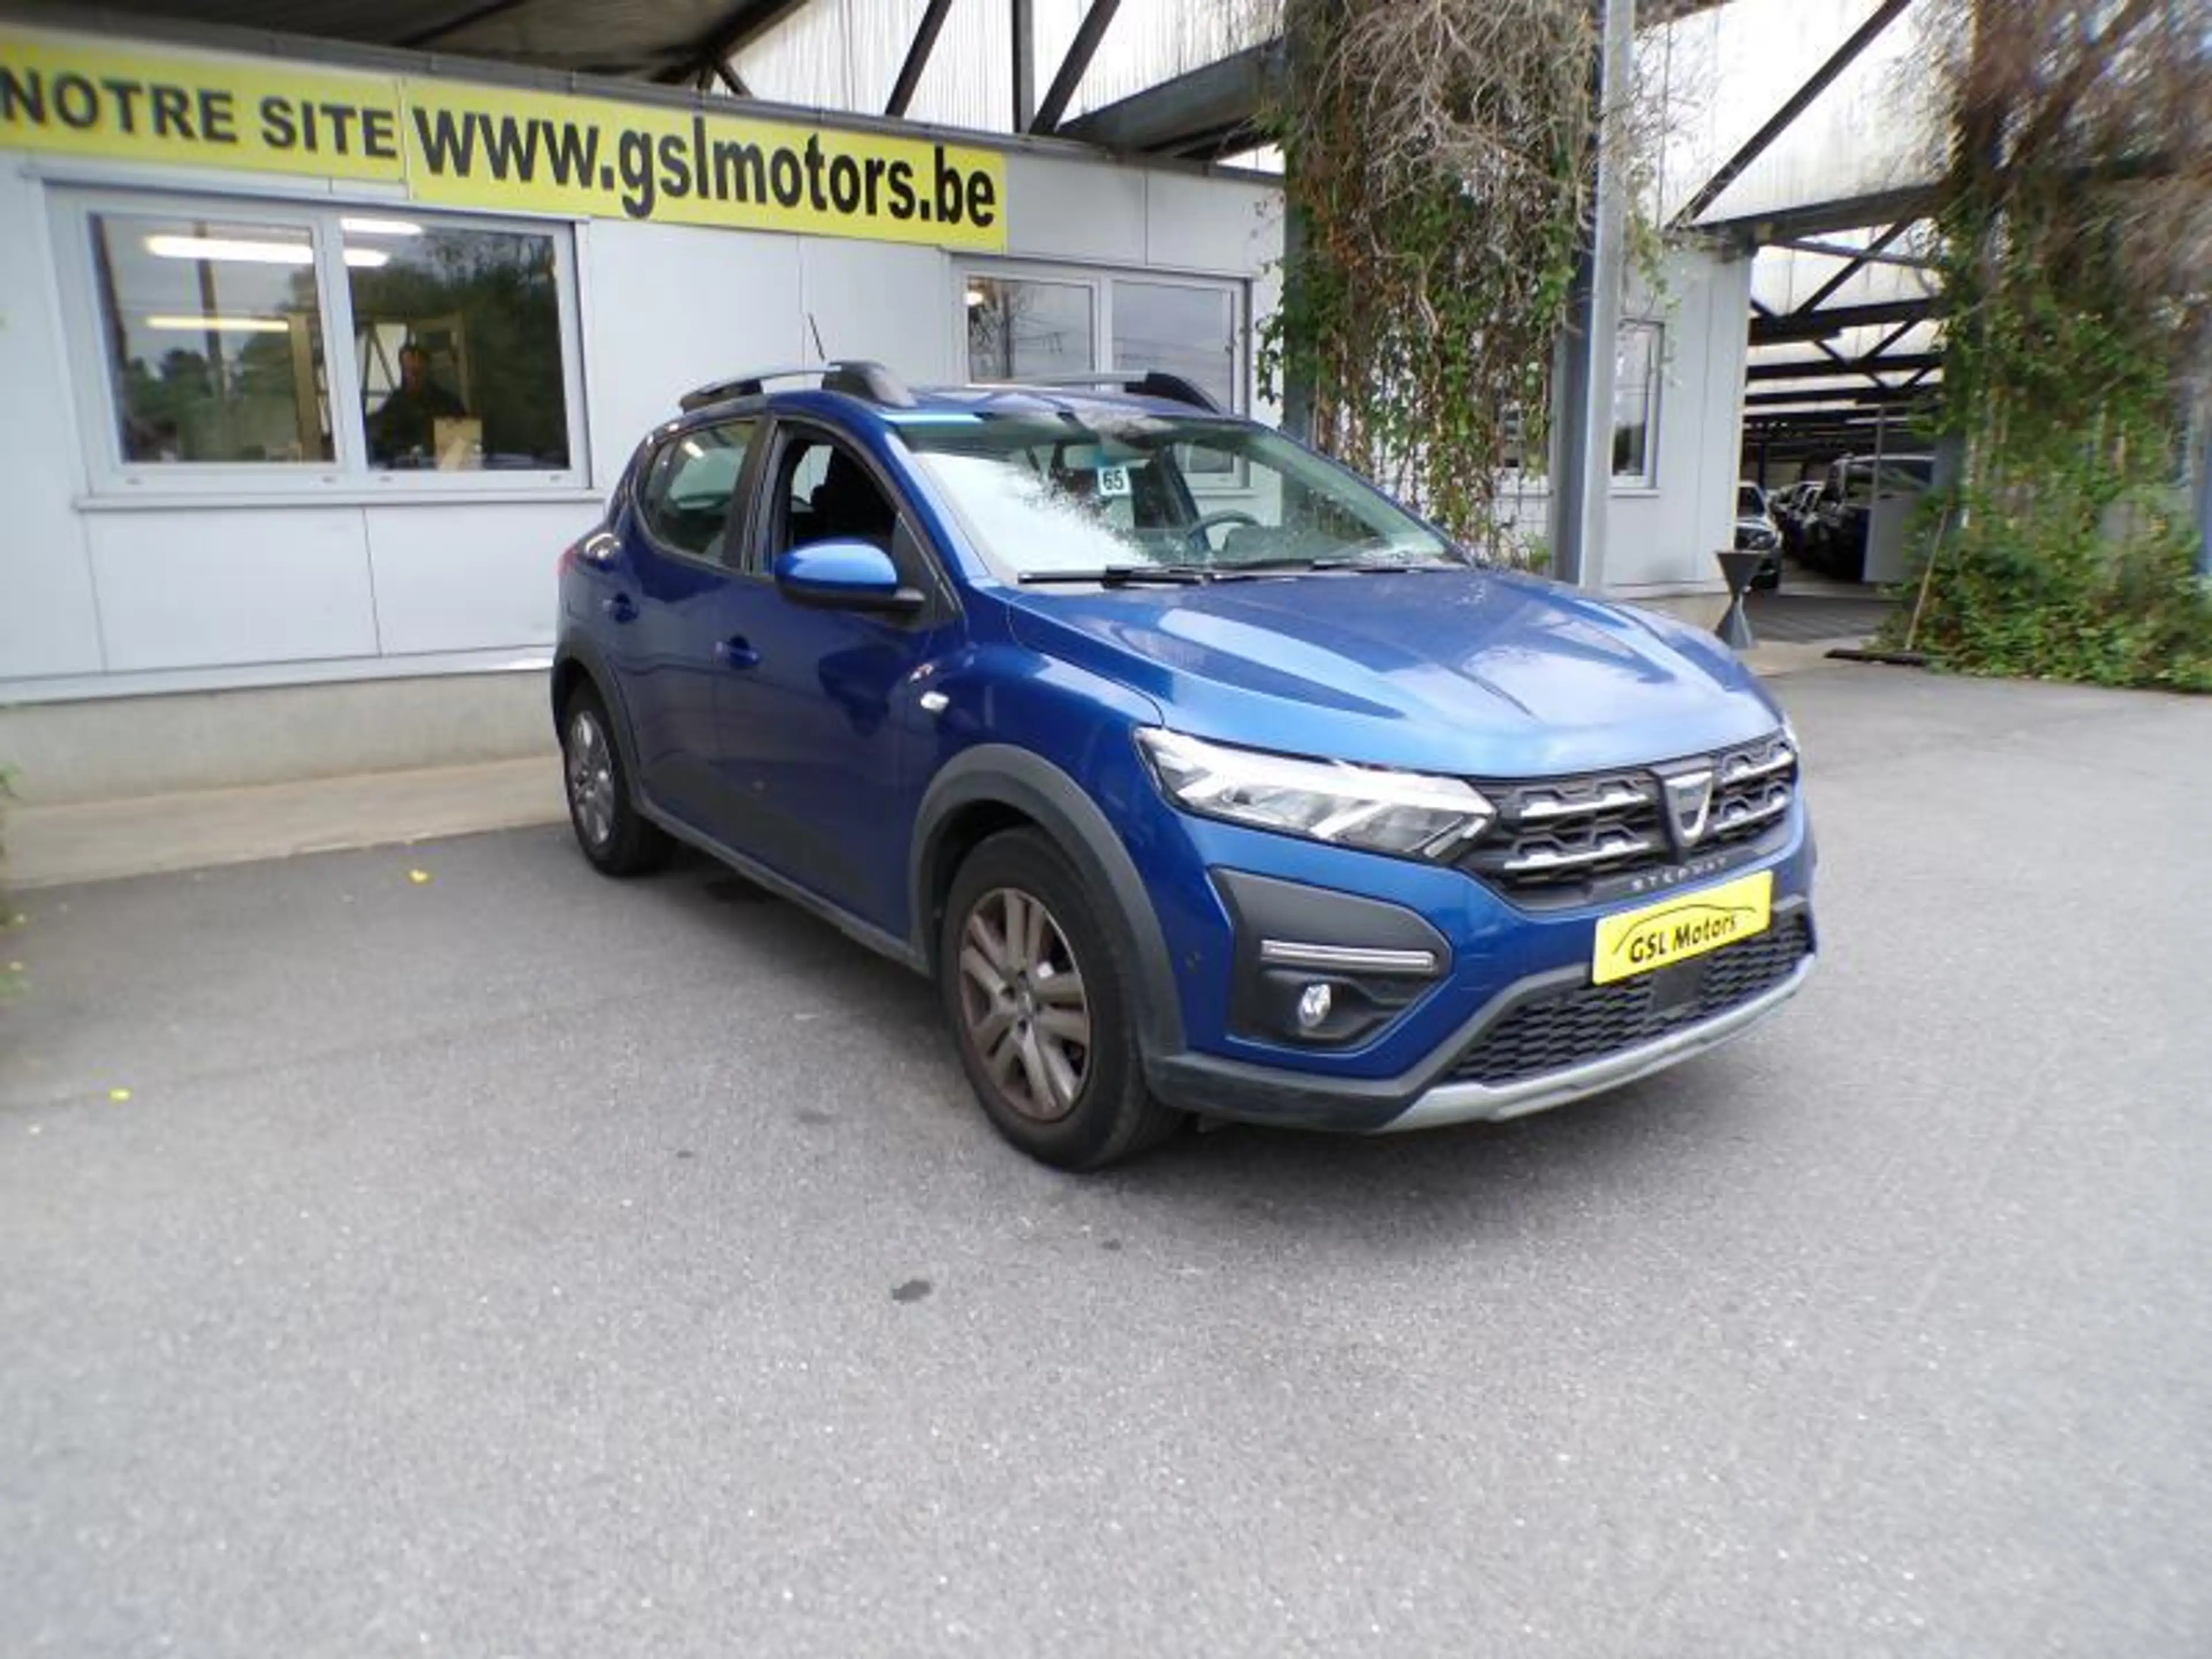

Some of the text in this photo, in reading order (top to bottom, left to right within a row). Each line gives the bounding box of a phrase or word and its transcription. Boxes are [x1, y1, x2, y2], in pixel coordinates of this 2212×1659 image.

[0, 65, 397, 158] NOTRE SITE
[1103, 469, 1124, 490] 65
[1630, 915, 1737, 963] GSL Motors
